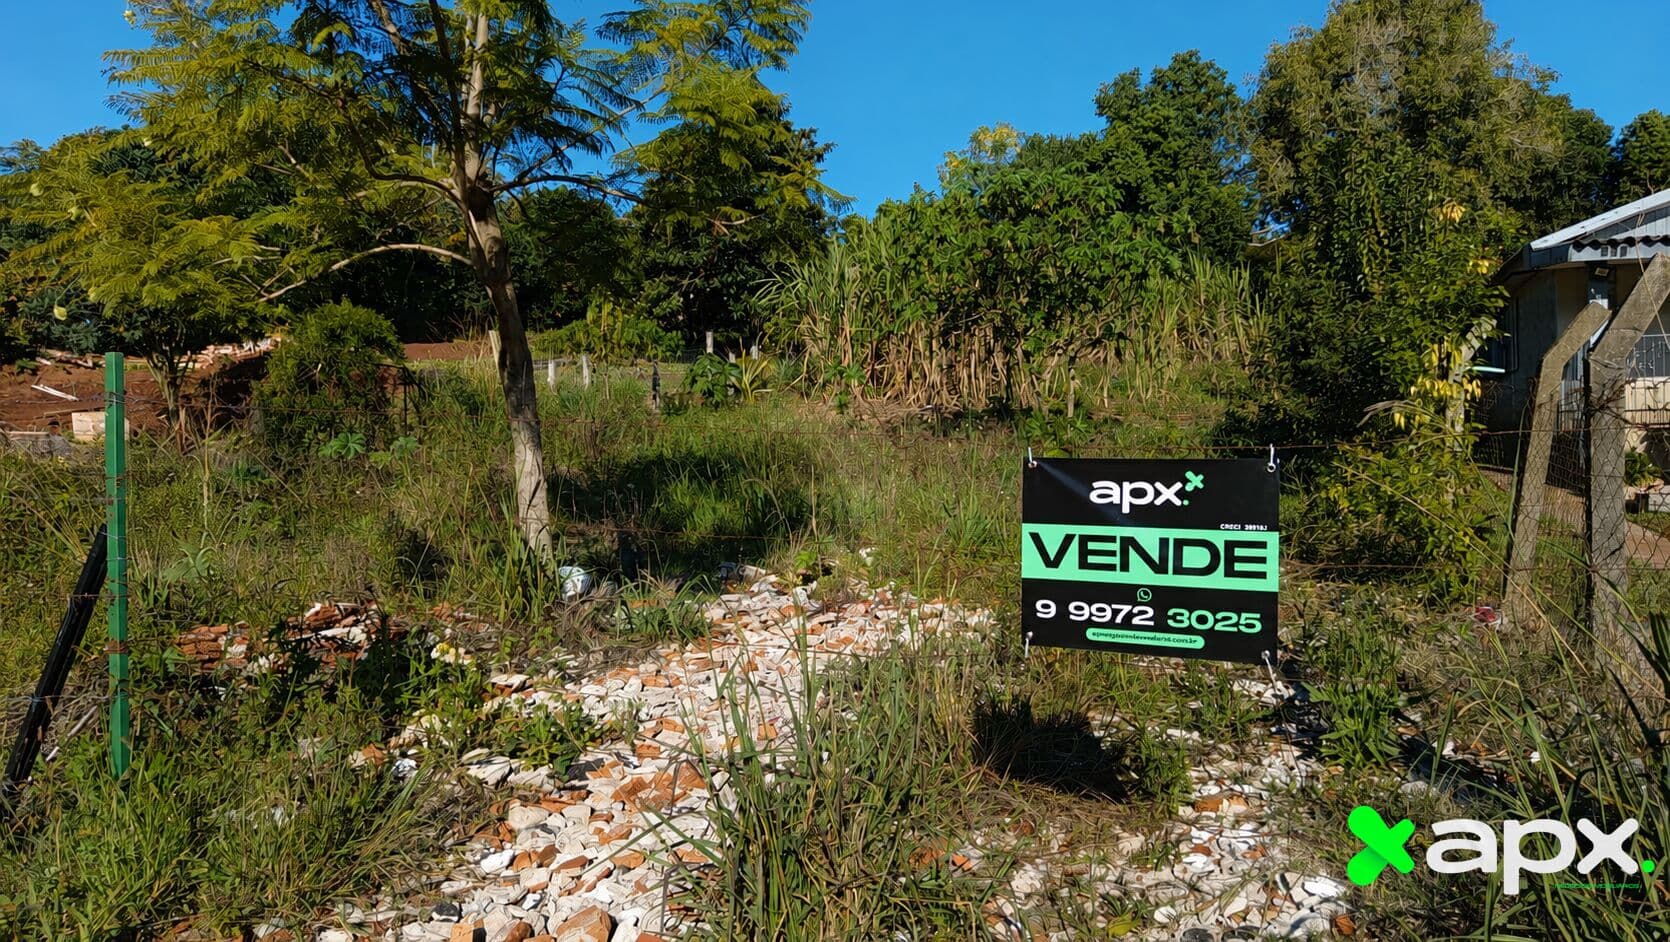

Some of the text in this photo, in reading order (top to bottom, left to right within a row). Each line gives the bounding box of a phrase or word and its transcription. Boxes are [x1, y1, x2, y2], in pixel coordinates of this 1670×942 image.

[1028, 531, 1267, 580] VENDE
[1035, 599, 1263, 634] 9 9972 3025
